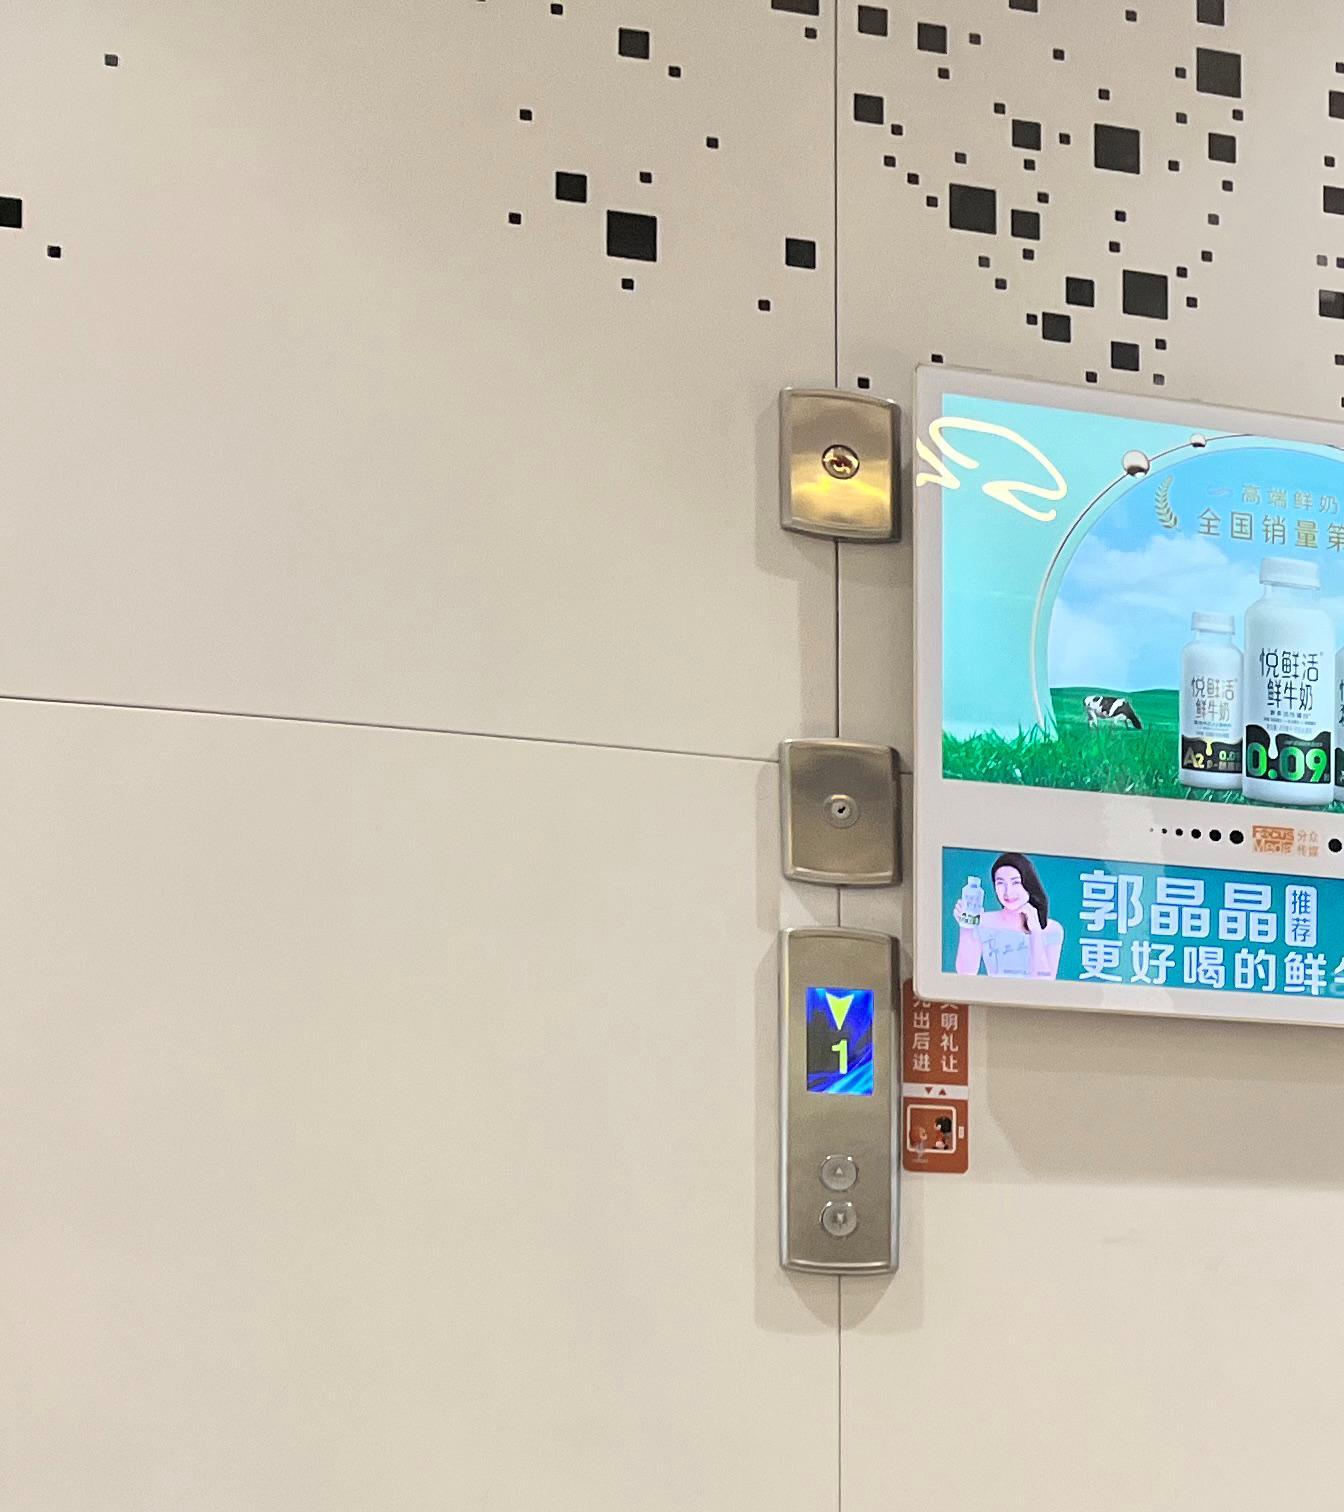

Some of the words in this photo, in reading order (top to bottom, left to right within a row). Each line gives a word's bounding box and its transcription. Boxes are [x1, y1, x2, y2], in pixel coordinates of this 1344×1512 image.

[1241, 484, 1340, 515] 高端鲜奶
[1259, 648, 1320, 682] 悦鲜活
[1195, 698, 1231, 721] 鲜牛奶
[1266, 678, 1313, 711] 鲜牛奶
[1247, 742, 1328, 783] 0.09
[1079, 870, 1278, 943] 郭晶晶
[1291, 889, 1312, 943] 推荐
[832, 1039, 848, 1075] 1
